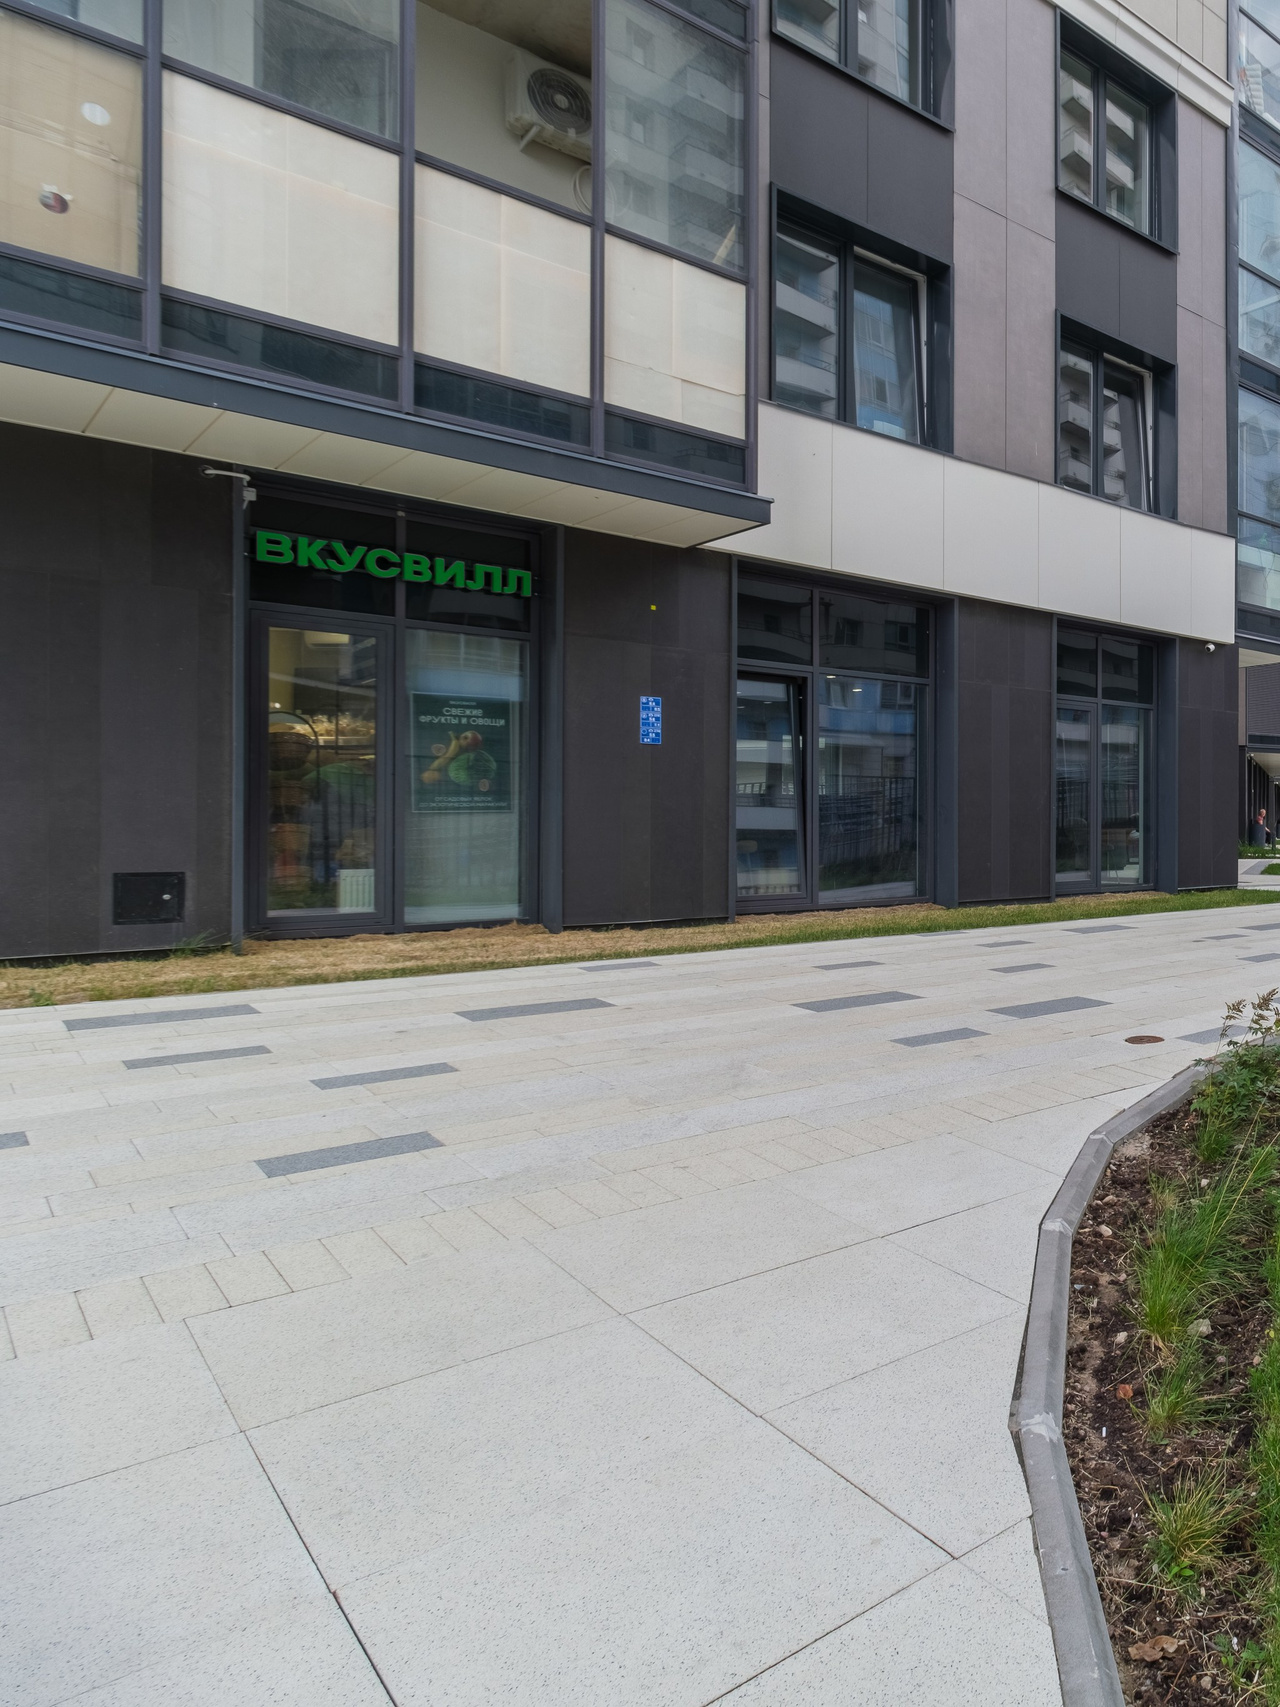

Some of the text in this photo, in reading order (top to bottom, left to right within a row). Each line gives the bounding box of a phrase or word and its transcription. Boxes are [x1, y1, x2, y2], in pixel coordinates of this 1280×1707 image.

[256, 530, 532, 597] ВКУСВИЛЛ
[418, 715, 506, 727] ФРУКТЫ И ОВОЩИ
